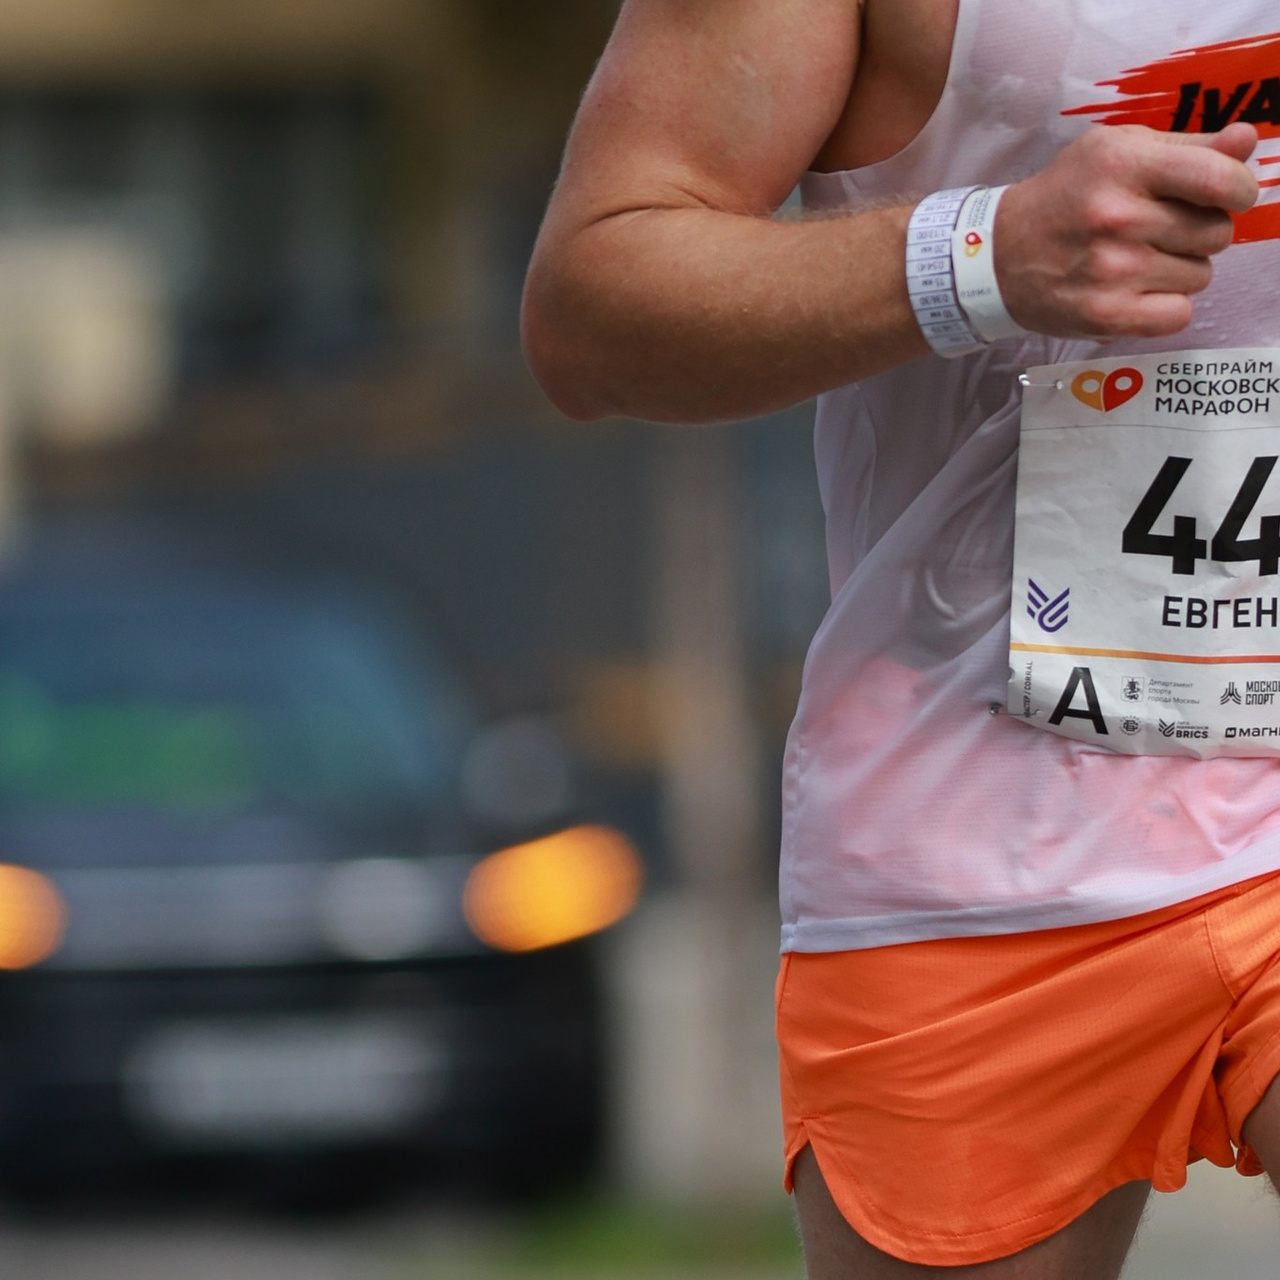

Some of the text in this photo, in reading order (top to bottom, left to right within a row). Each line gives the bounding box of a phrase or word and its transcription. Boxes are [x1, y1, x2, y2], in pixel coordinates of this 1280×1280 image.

[1156, 359, 1273, 375] СБЕРПРАЙМ
[1155, 397, 1270, 416] МАРАФОН
[1024, 660, 1033, 690] CORRAL
[1245, 693, 1275, 706] СПОРТ
[1175, 729, 1209, 739] BRICS
